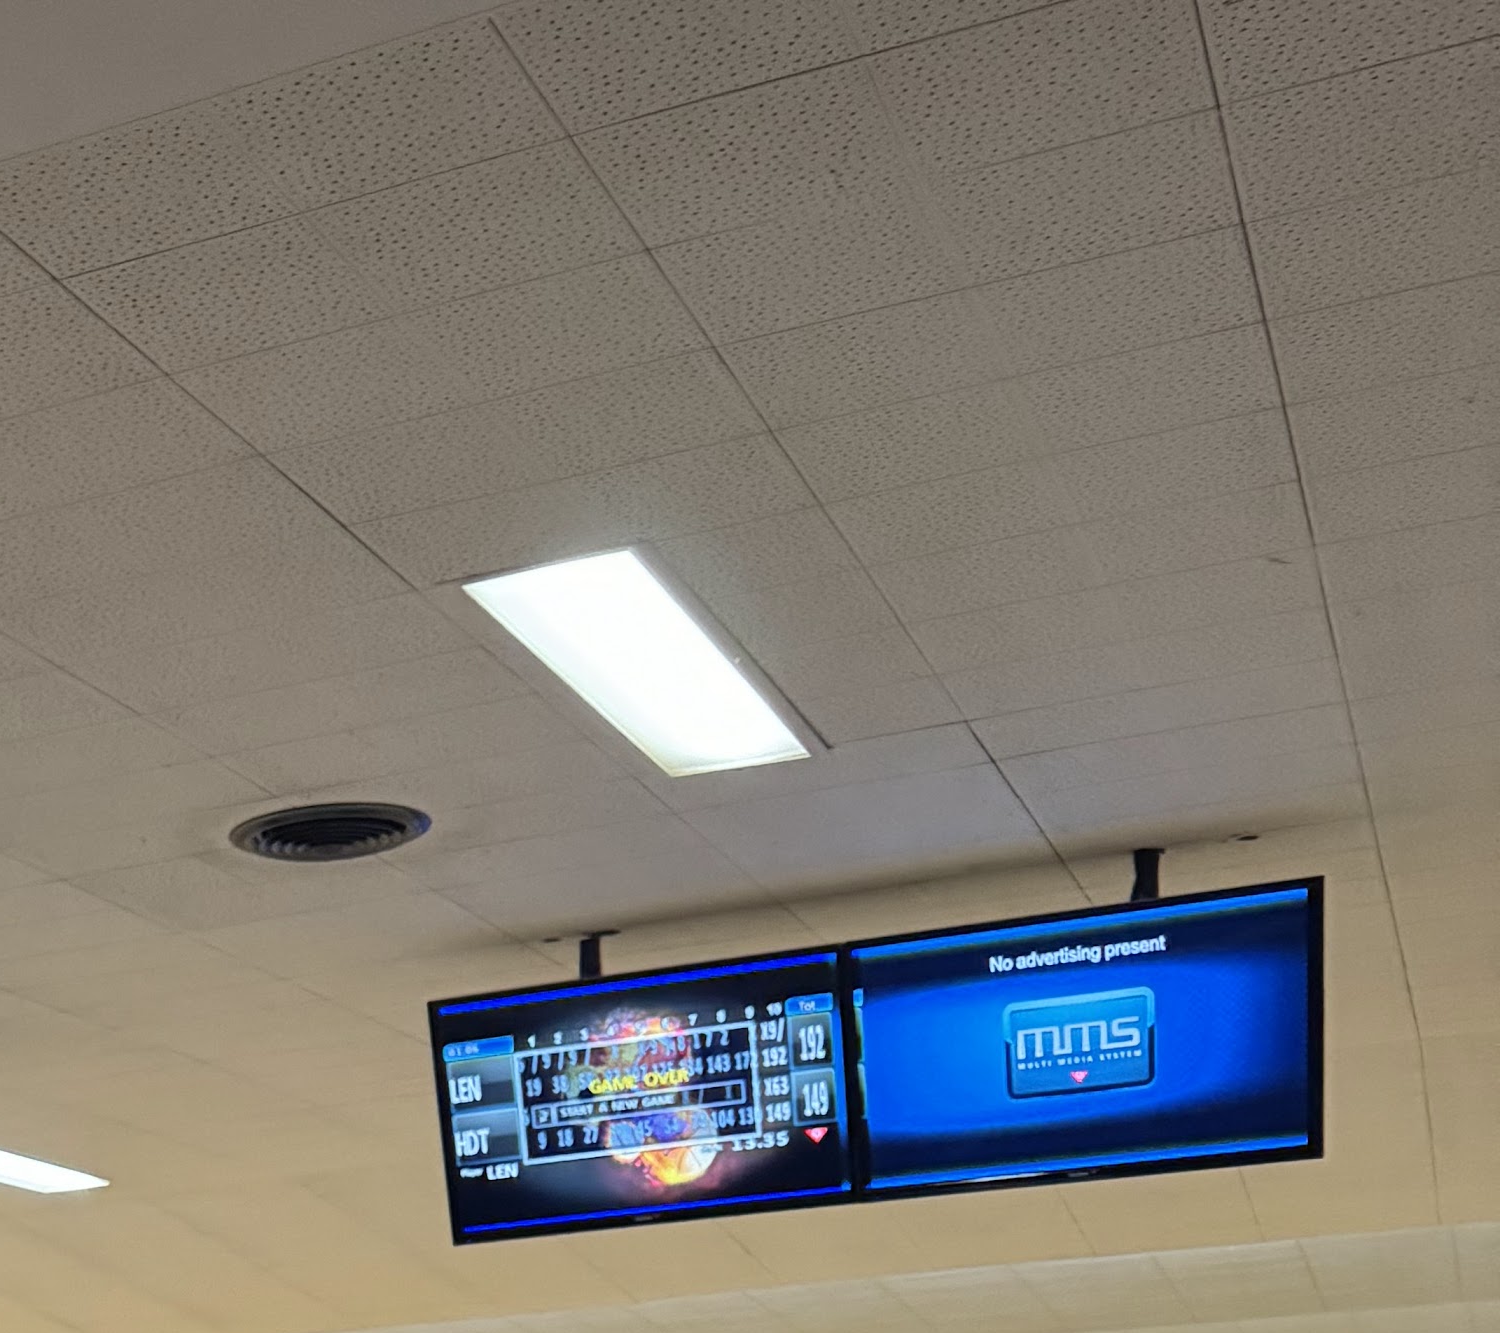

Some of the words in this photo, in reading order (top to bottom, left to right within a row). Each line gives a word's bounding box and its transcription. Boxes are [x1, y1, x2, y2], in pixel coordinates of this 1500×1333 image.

[988, 955, 1014, 973] No
[1015, 945, 1102, 970] advertising
[1104, 935, 1167, 962] present
[688, 1013, 698, 1026] 7
[798, 1024, 827, 1061] 192
[1017, 1060, 1052, 1070] MULTI
[1057, 1055, 1093, 1066] MEDIA
[1099, 1049, 1142, 1061] SYSTEM
[449, 1075, 482, 1104] LEN
[526, 1077, 542, 1097] 19
[706, 1050, 731, 1075] 143
[762, 1046, 788, 1067] 192
[588, 1074, 637, 1095] GAME
[643, 1068, 690, 1087] OVER
[802, 1081, 829, 1117] 149
[454, 1127, 490, 1157] HDT
[766, 1101, 791, 1123] 149
[486, 1163, 519, 1180] LEN
